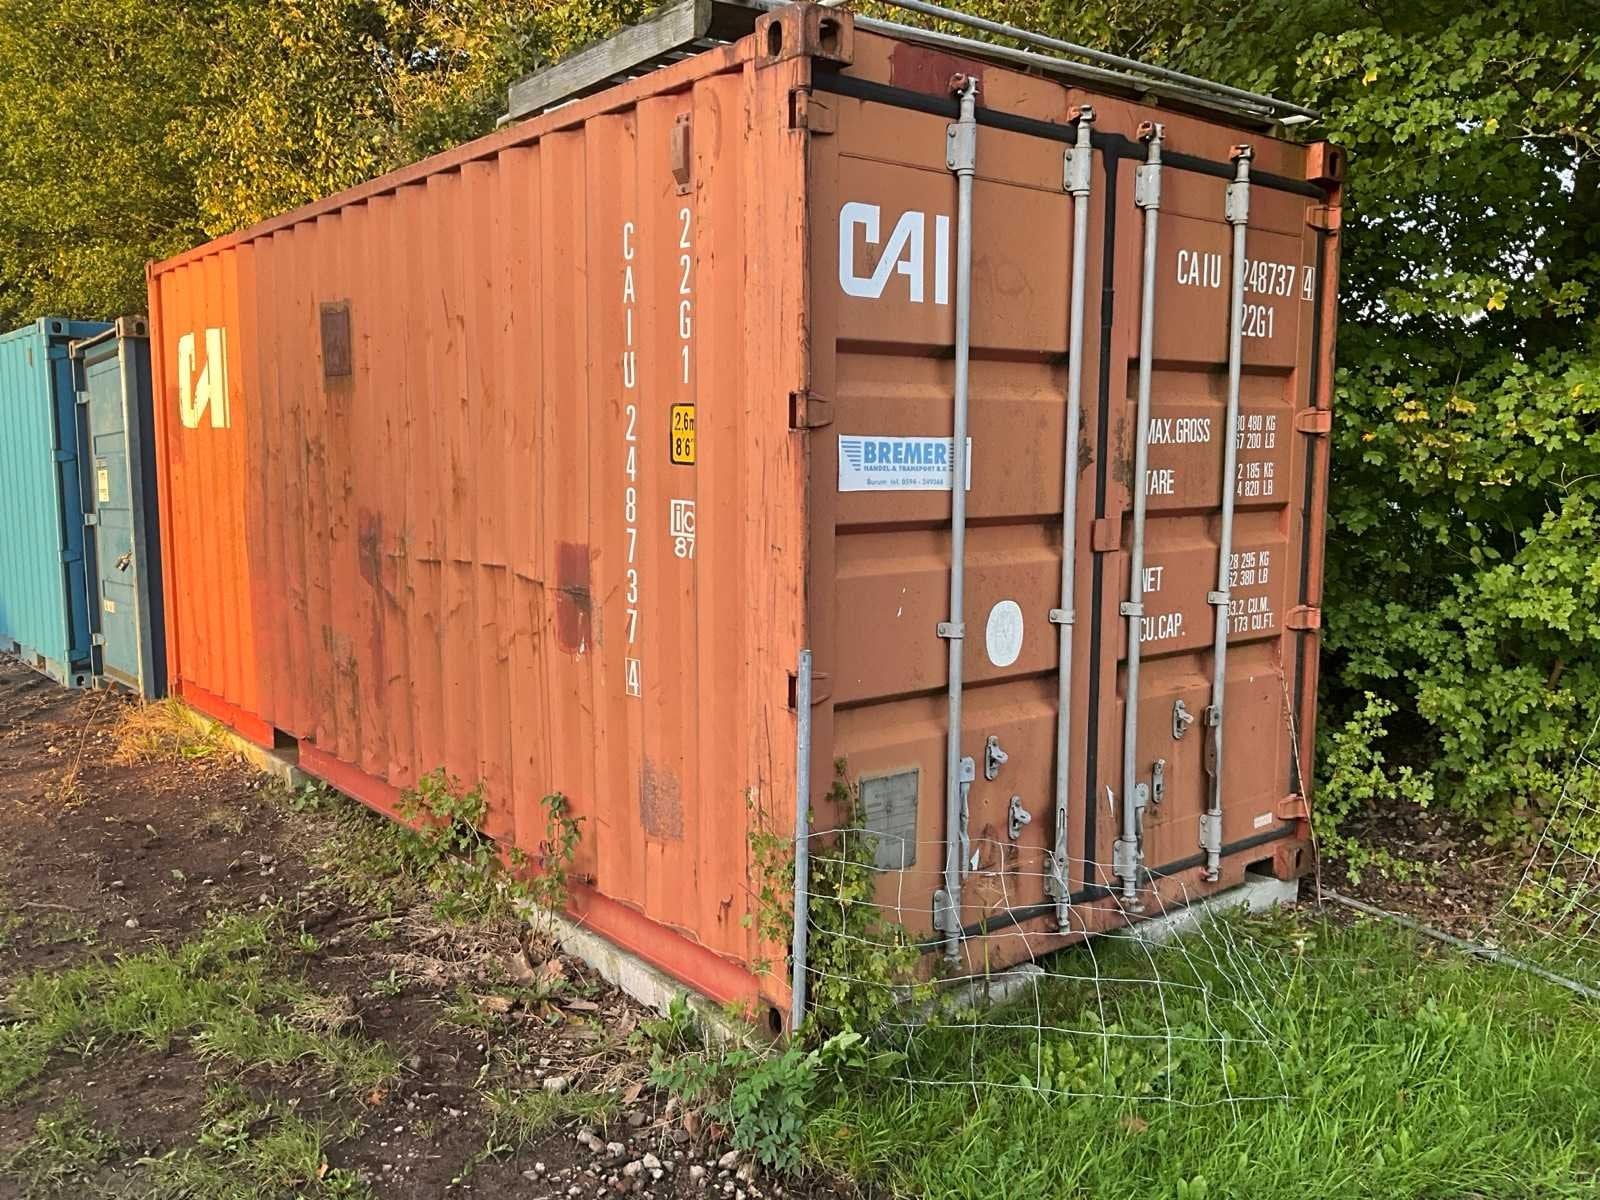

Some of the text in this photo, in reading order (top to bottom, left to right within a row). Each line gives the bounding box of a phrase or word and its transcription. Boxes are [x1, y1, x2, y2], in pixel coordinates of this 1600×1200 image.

[839, 202, 949, 304] CAI
[1177, 250, 1314, 300] CAIU 248737 4
[679, 208, 691, 384] 22G1
[1241, 304, 1274, 338] 22G1
[178, 328, 231, 428] CAI
[1148, 418, 1211, 444] MAX.GROSS
[1248, 415, 1262, 431] 480
[1265, 415, 1276, 431] KG
[864, 441, 947, 464] BREMER
[1247, 433, 1261, 449] 200
[1264, 433, 1275, 449] LB
[624, 222, 640, 696] CAIU 248737 4
[1237, 462, 1274, 479] 2 185 KG
[1145, 469, 1175, 495] TARE
[1237, 480, 1273, 497] 4 820 LB
[675, 537, 694, 559] 87
[1241, 551, 1256, 568] 295
[1259, 551, 1269, 567] KG
[1240, 570, 1254, 586] 380
[1258, 568, 1268, 584] LB
[1139, 612, 1186, 642] CU.CAP.
[1234, 616, 1248, 633] 173
[1252, 613, 1275, 630] CU.FT.
